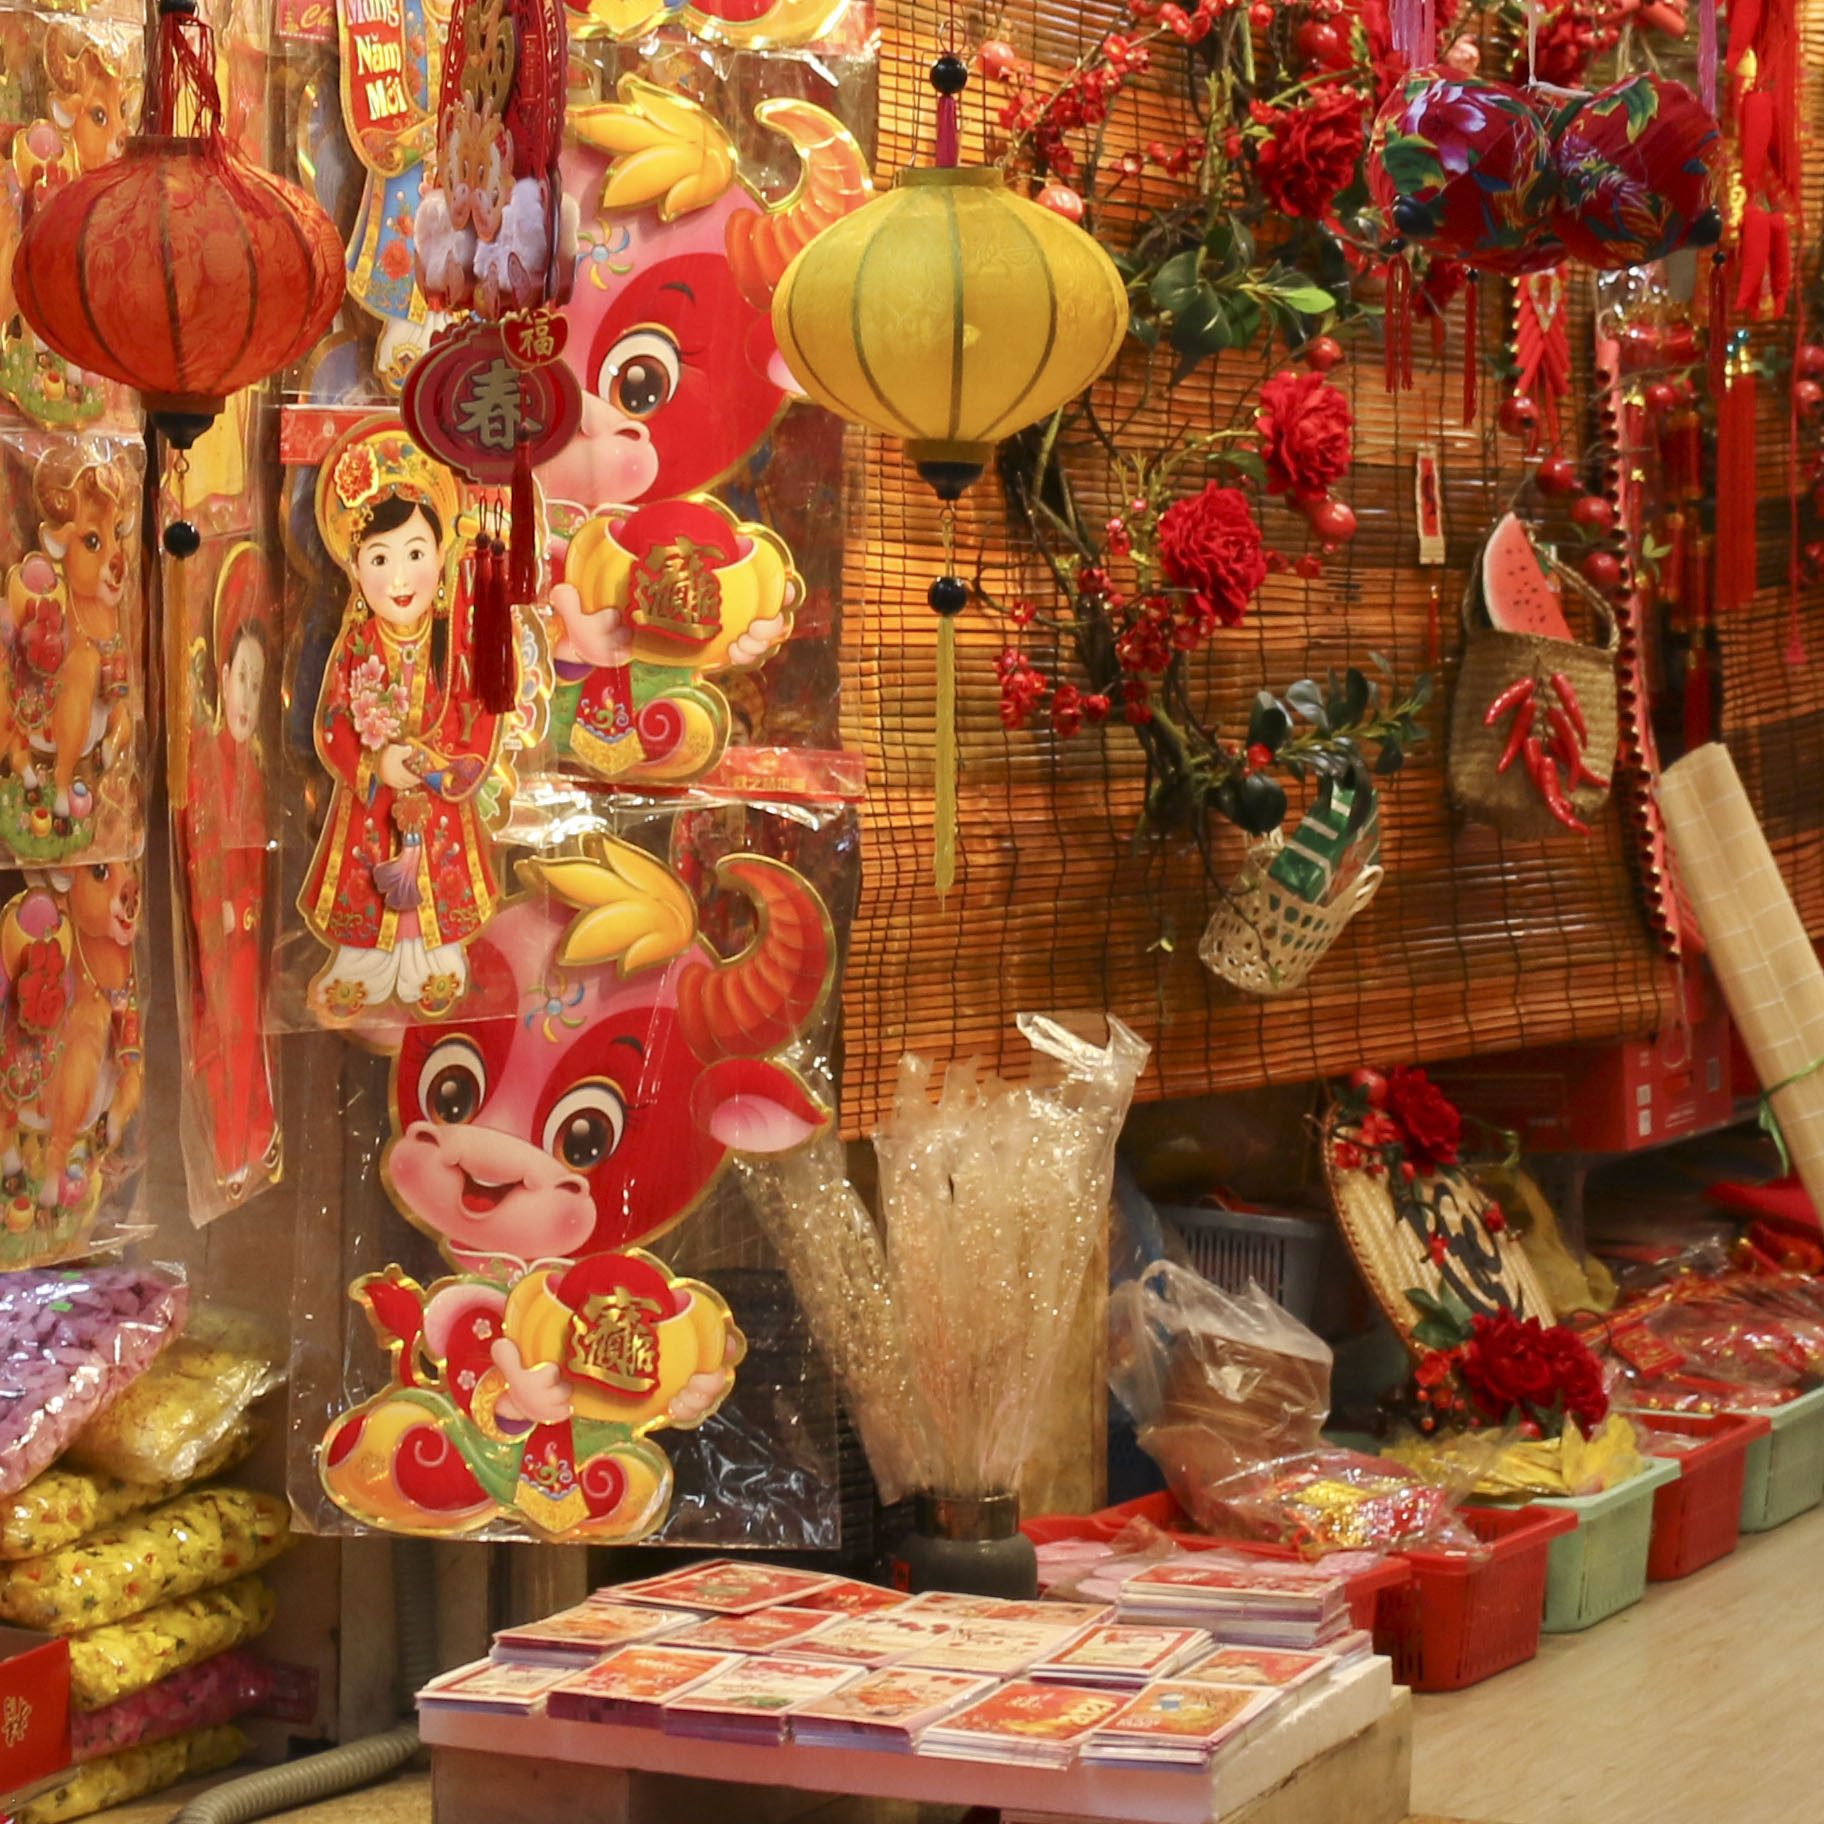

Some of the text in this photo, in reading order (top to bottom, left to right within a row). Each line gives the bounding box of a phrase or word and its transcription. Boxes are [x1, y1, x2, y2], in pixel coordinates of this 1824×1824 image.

[354, 32, 402, 75] Năm
[366, 76, 408, 121] Mới
[518, 316, 556, 357] 福
[456, 360, 543, 451] 春
